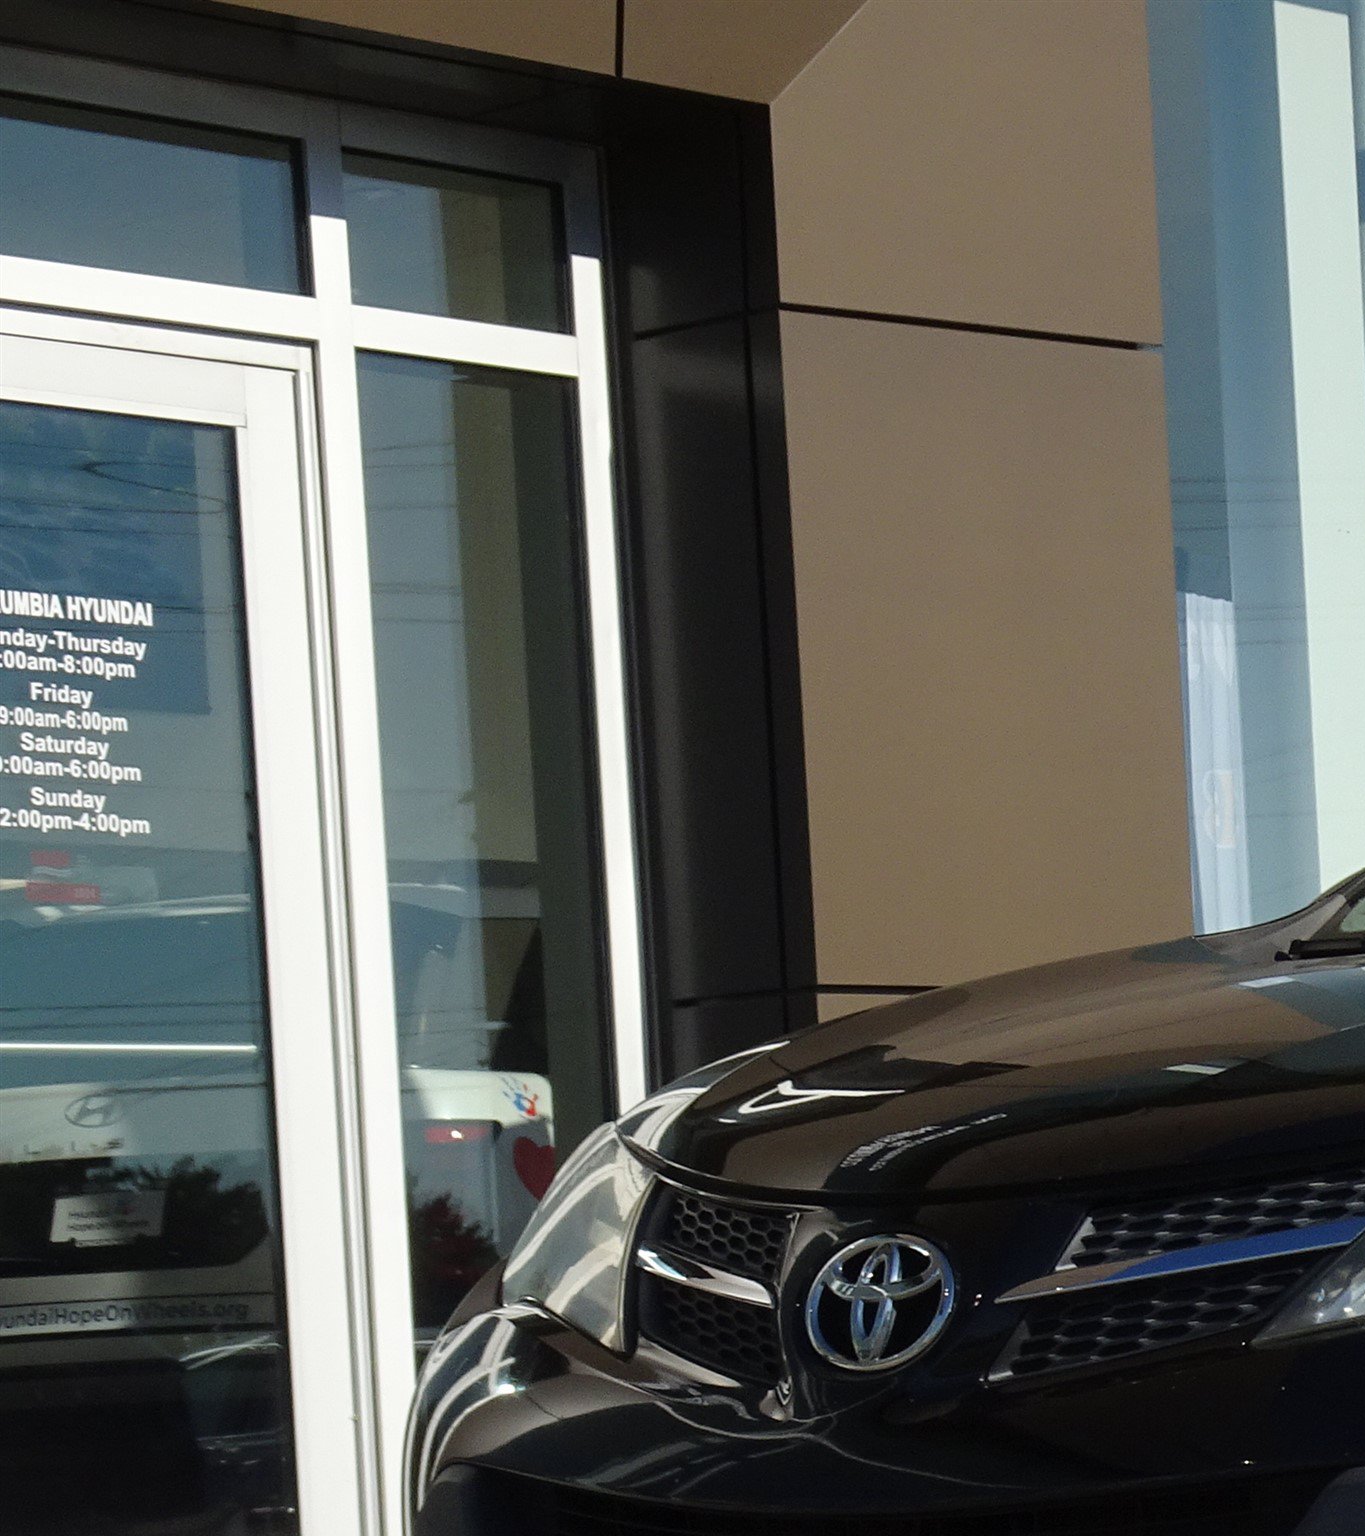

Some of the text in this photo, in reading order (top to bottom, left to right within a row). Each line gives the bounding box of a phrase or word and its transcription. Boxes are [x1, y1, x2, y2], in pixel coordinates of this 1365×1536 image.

[0, 588, 153, 627] UMBIA HYUNDAI
[30, 681, 93, 709] Friday
[0, 705, 128, 735] 9:00am-6:00pm
[20, 732, 109, 760] Saturday
[30, 786, 106, 813] Sunday
